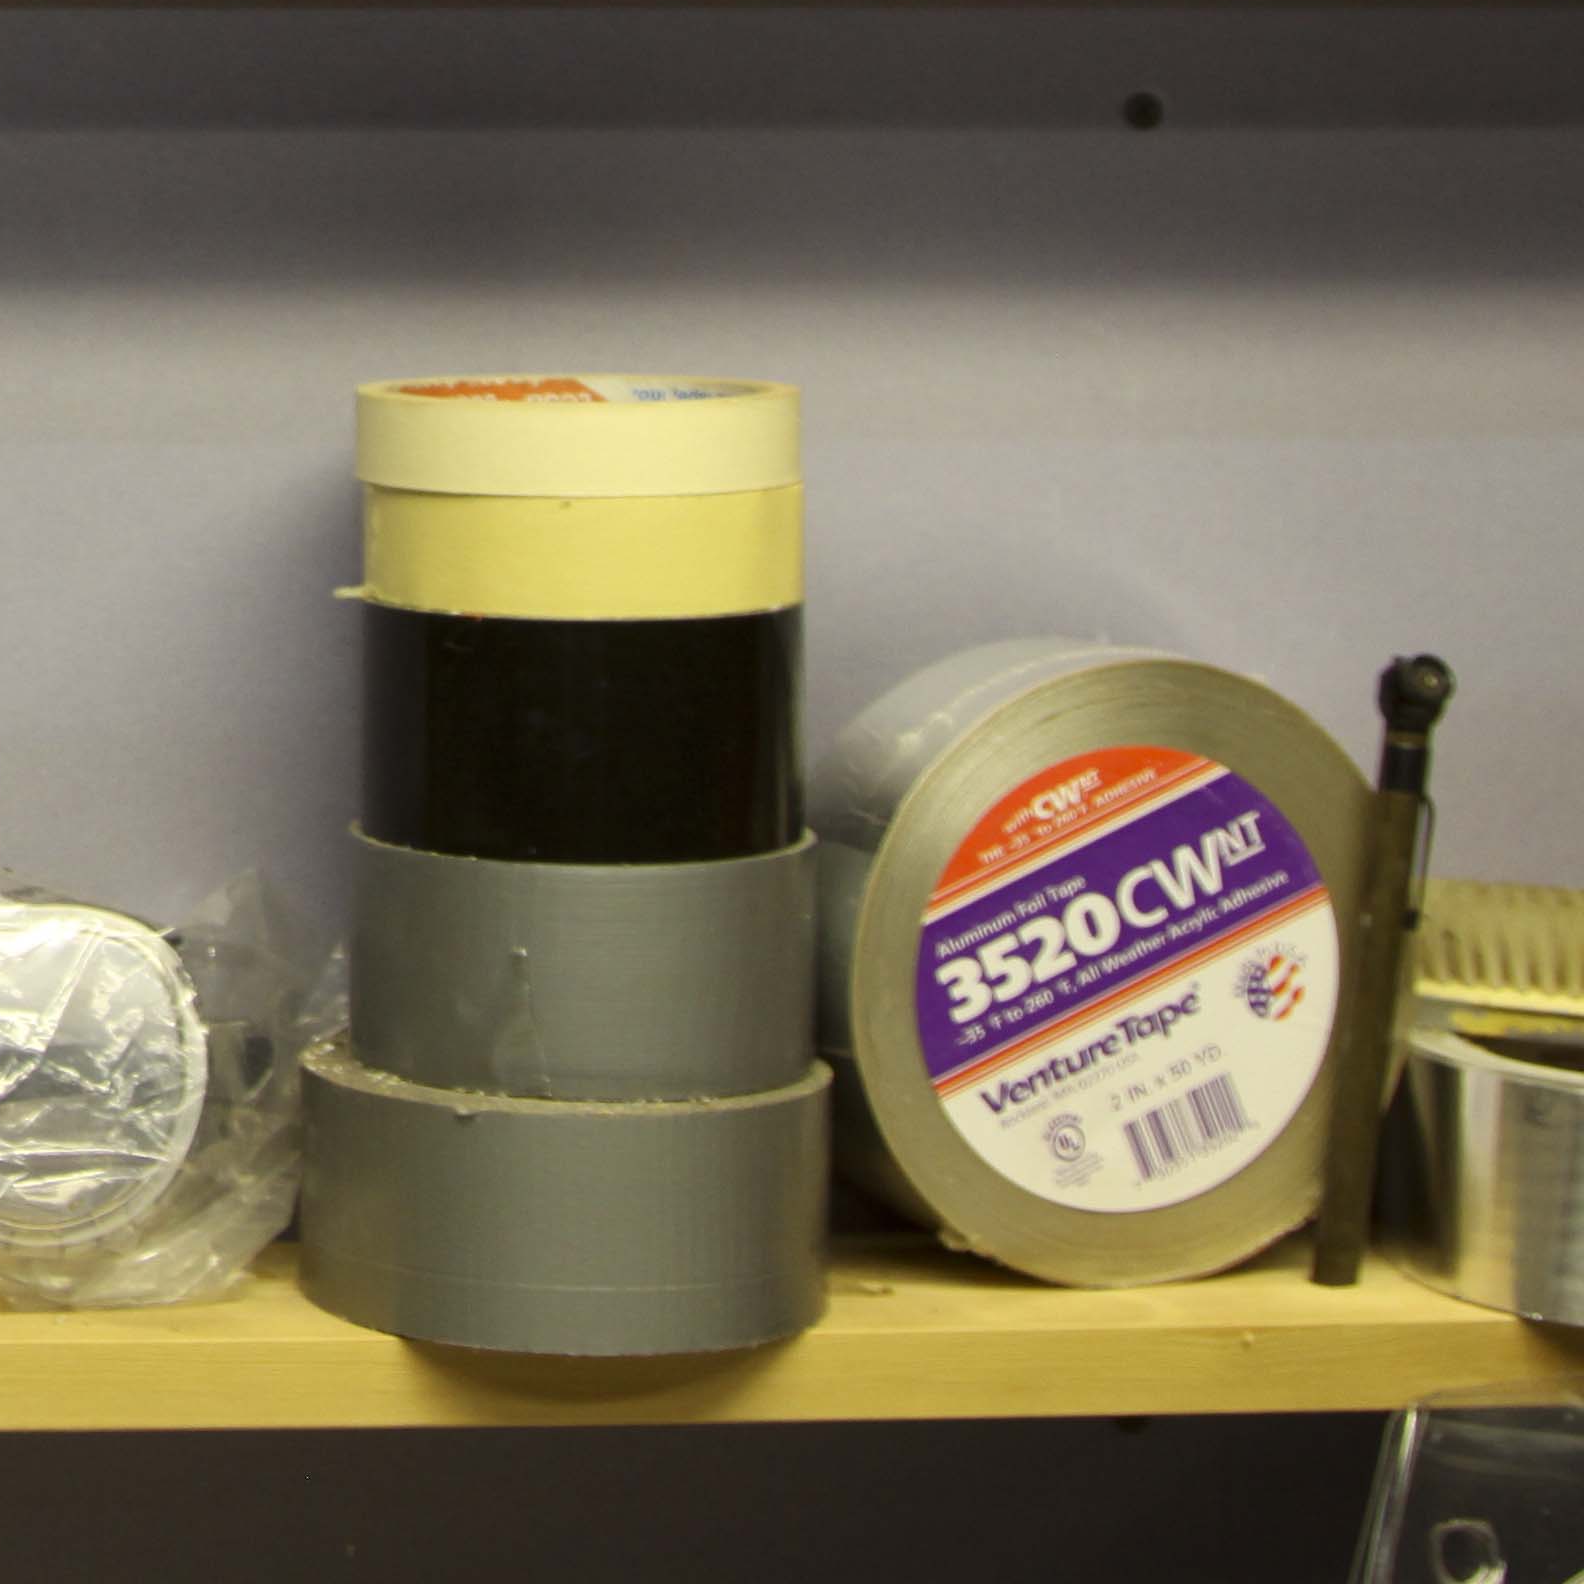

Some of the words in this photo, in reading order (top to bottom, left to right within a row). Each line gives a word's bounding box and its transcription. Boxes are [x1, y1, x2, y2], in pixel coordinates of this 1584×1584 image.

[934, 904, 1018, 961] Aluminum
[1014, 890, 1047, 921] Foil
[1048, 874, 1087, 903] Tape
[1026, 989, 1055, 1014] 260
[1078, 961, 1102, 988] All
[1101, 930, 1168, 974] Weather
[1169, 906, 1220, 941] Acrylic
[1220, 870, 1289, 915] Adhesive
